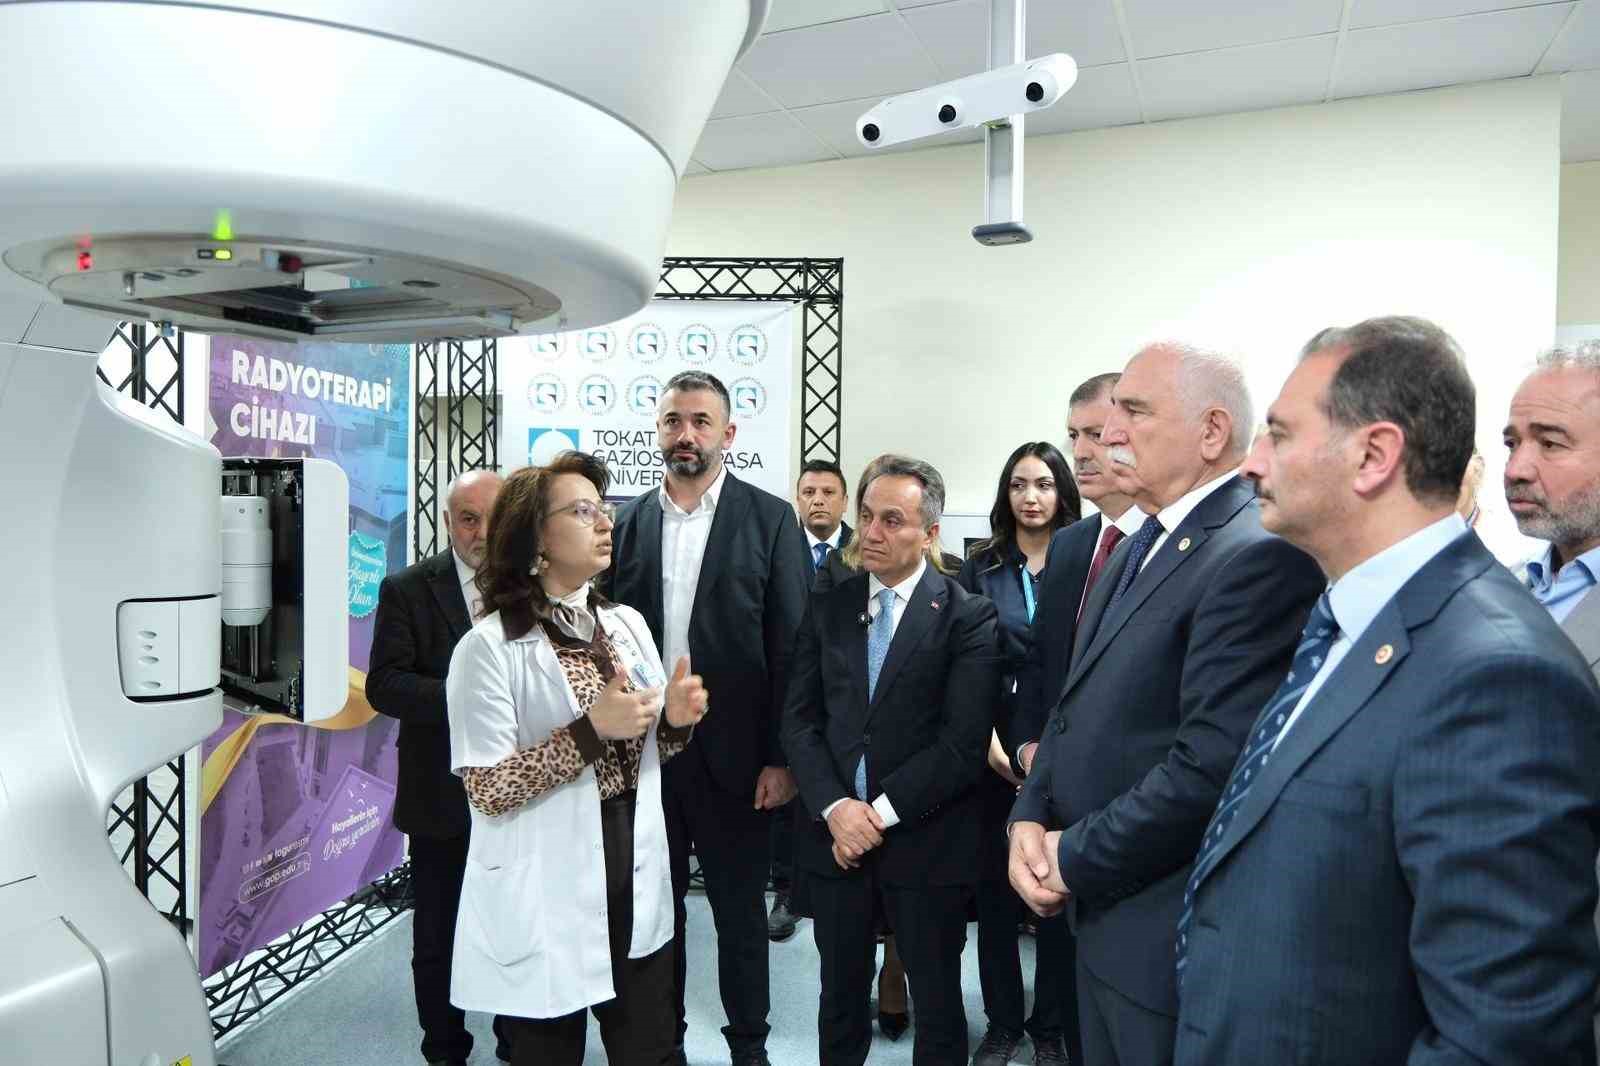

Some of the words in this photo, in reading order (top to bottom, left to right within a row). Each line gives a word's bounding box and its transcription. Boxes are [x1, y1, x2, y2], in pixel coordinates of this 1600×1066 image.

[232, 349, 392, 412] RADYOTERAPİ
[230, 395, 316, 445] CİHAZI
[593, 430, 656, 446] TOKAT
